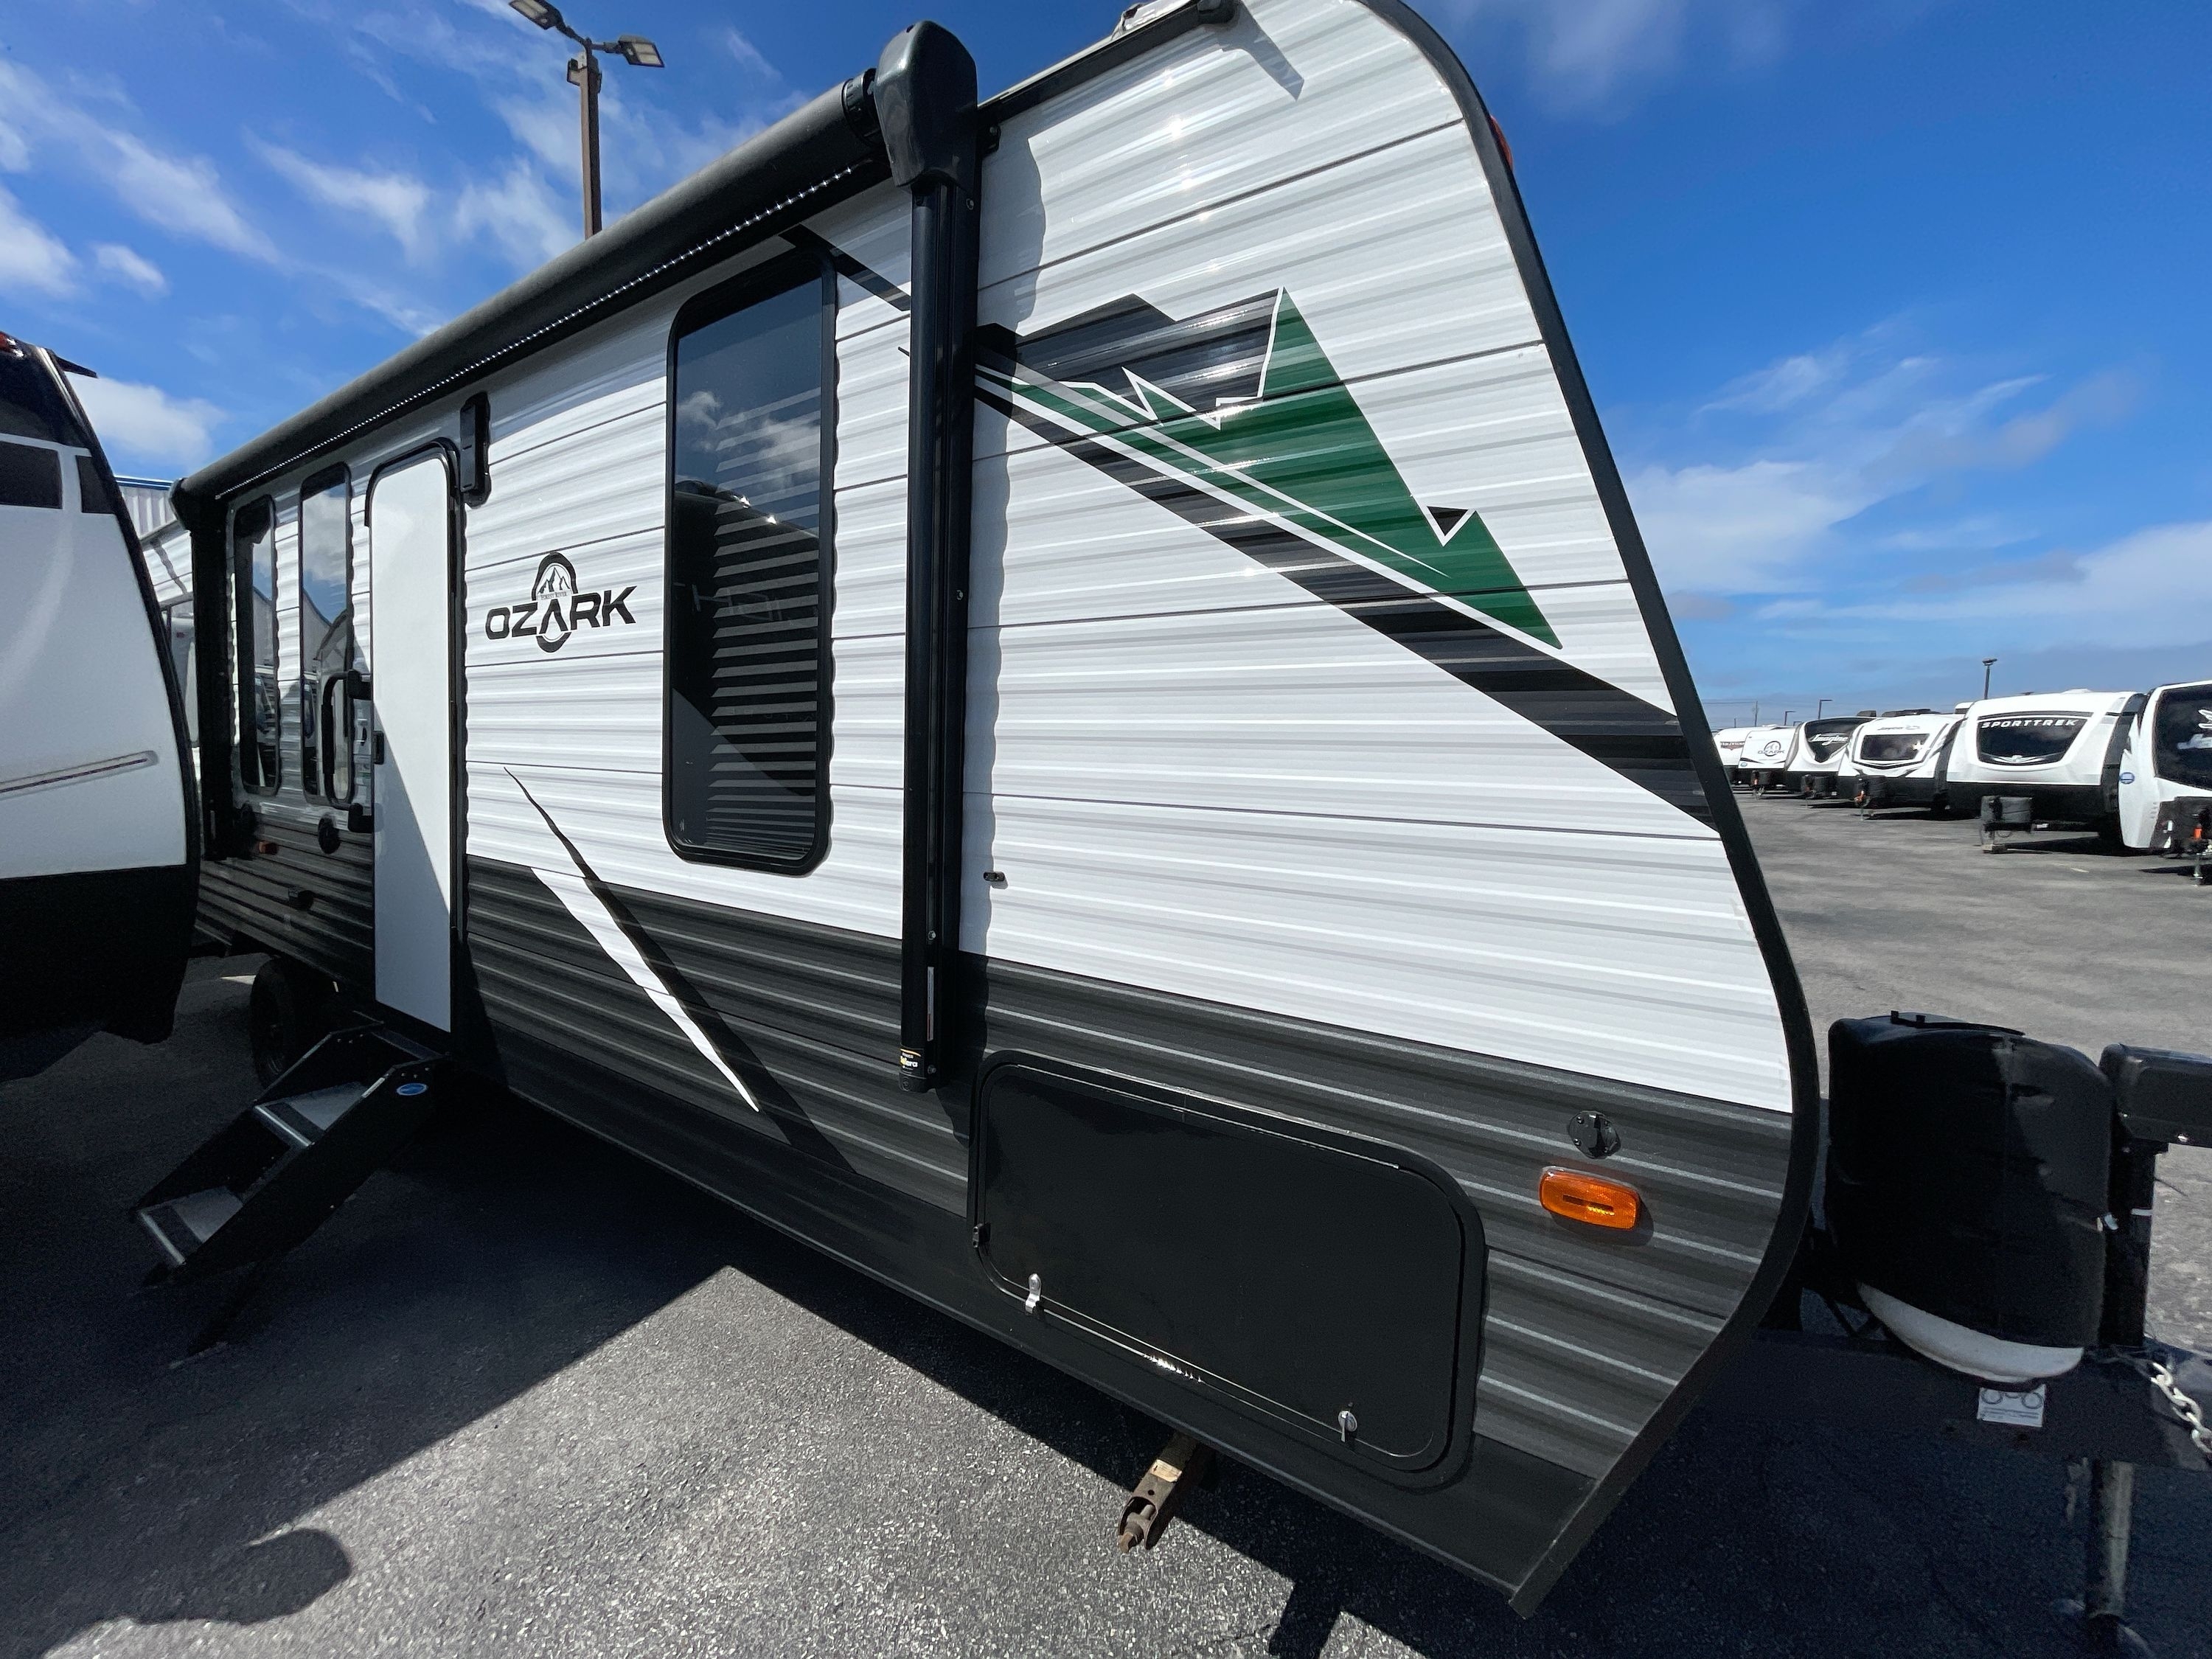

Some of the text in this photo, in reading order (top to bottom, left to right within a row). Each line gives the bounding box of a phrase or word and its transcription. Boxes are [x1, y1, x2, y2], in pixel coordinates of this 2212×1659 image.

[485, 585, 637, 639] OZARK
[1981, 719, 2079, 728] SPORTTREK
[1811, 733, 1849, 746] Imagine
